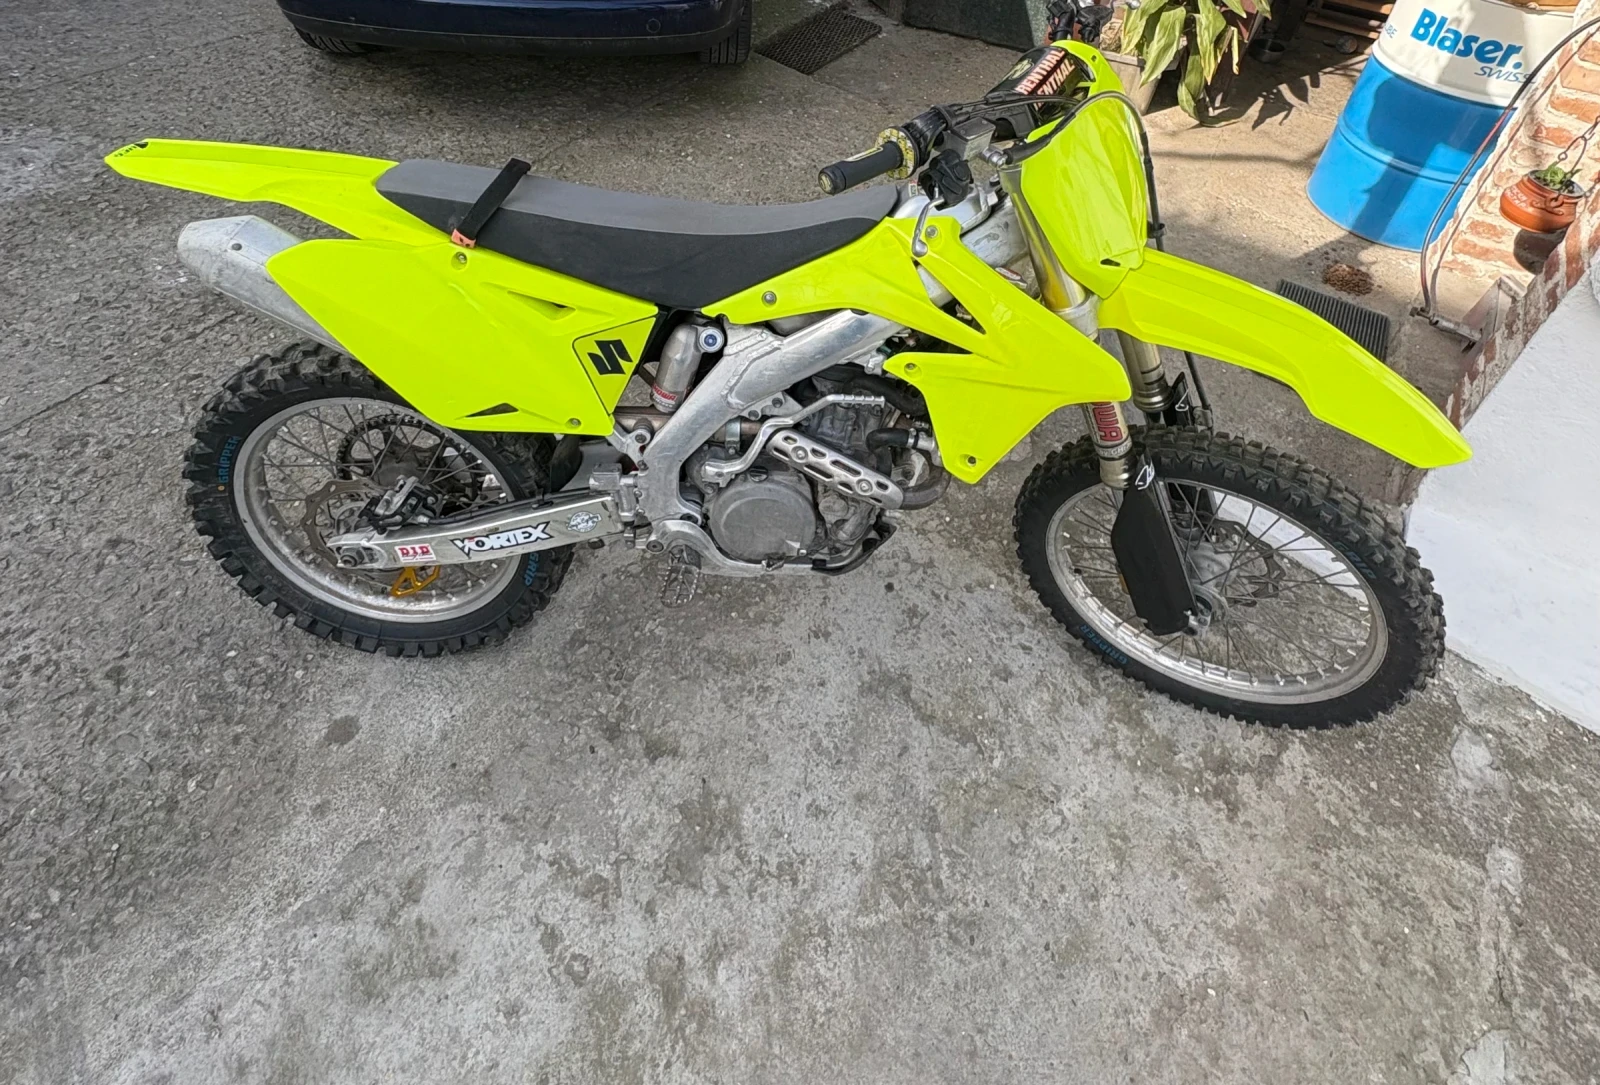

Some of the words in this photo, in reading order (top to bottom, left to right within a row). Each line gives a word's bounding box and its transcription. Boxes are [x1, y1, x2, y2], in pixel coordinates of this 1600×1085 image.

[1410, 8, 1524, 70] Blaser.
[1015, 49, 1066, 95] RENTHAL
[1091, 401, 1123, 442] WA
[218, 435, 240, 484] GRIPPER
[451, 522, 553, 557] VORTEX
